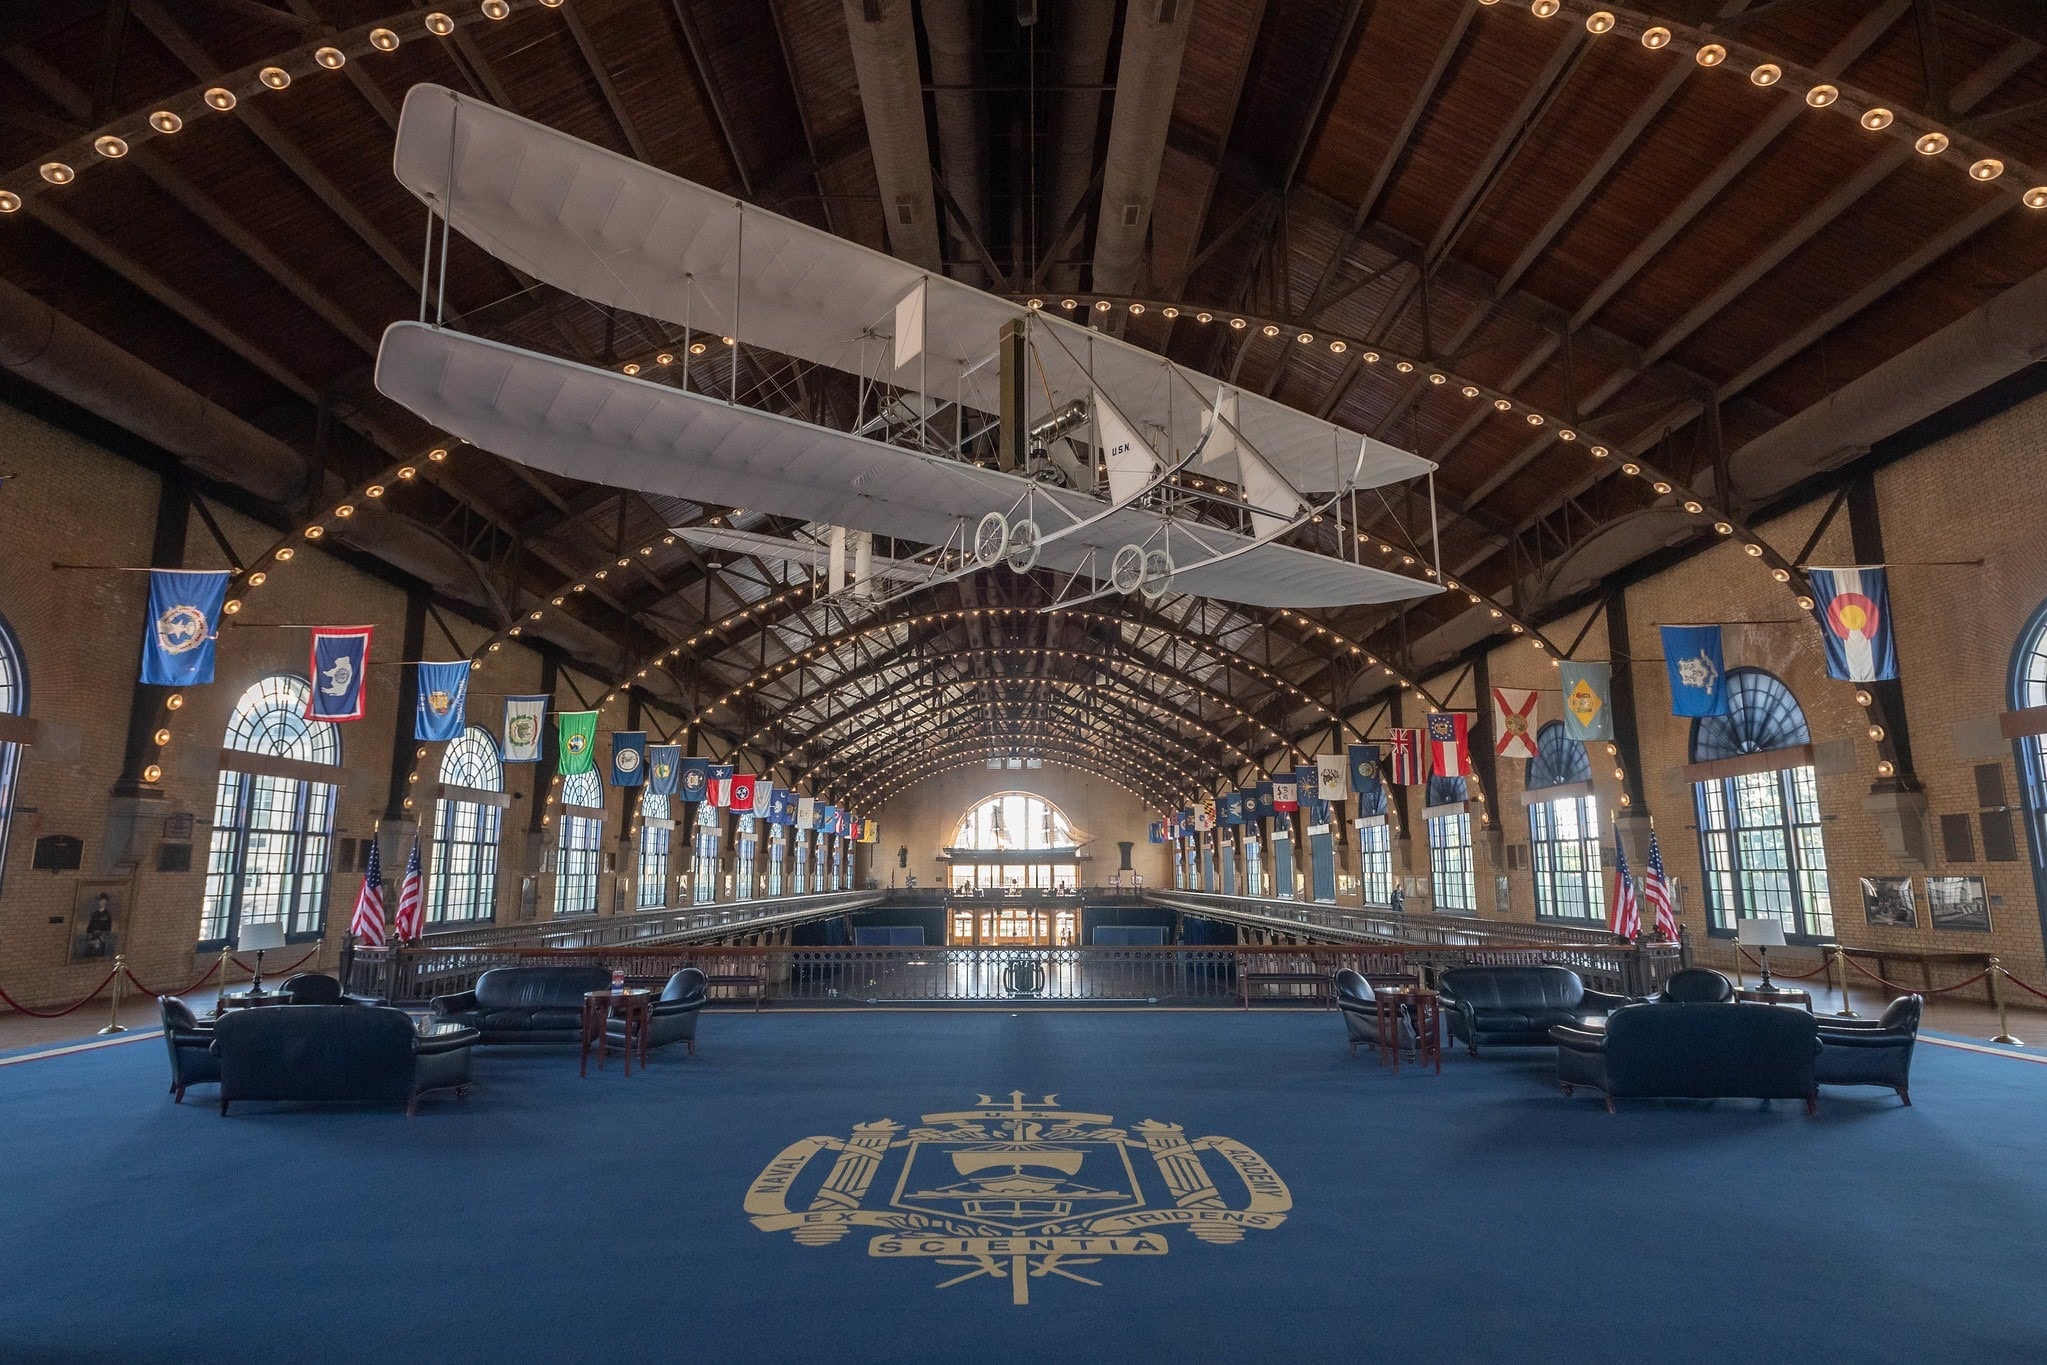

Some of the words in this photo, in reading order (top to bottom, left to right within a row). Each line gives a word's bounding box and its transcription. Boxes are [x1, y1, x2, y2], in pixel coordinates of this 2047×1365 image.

[1111, 443, 1130, 456] USN
[754, 1155, 806, 1194] NAVAL
[1226, 1149, 1284, 1198] ACADEMY
[803, 1212, 857, 1223] EX
[877, 1238, 1161, 1253] SCIENTIA
[1114, 1211, 1271, 1226] TRIDENS
